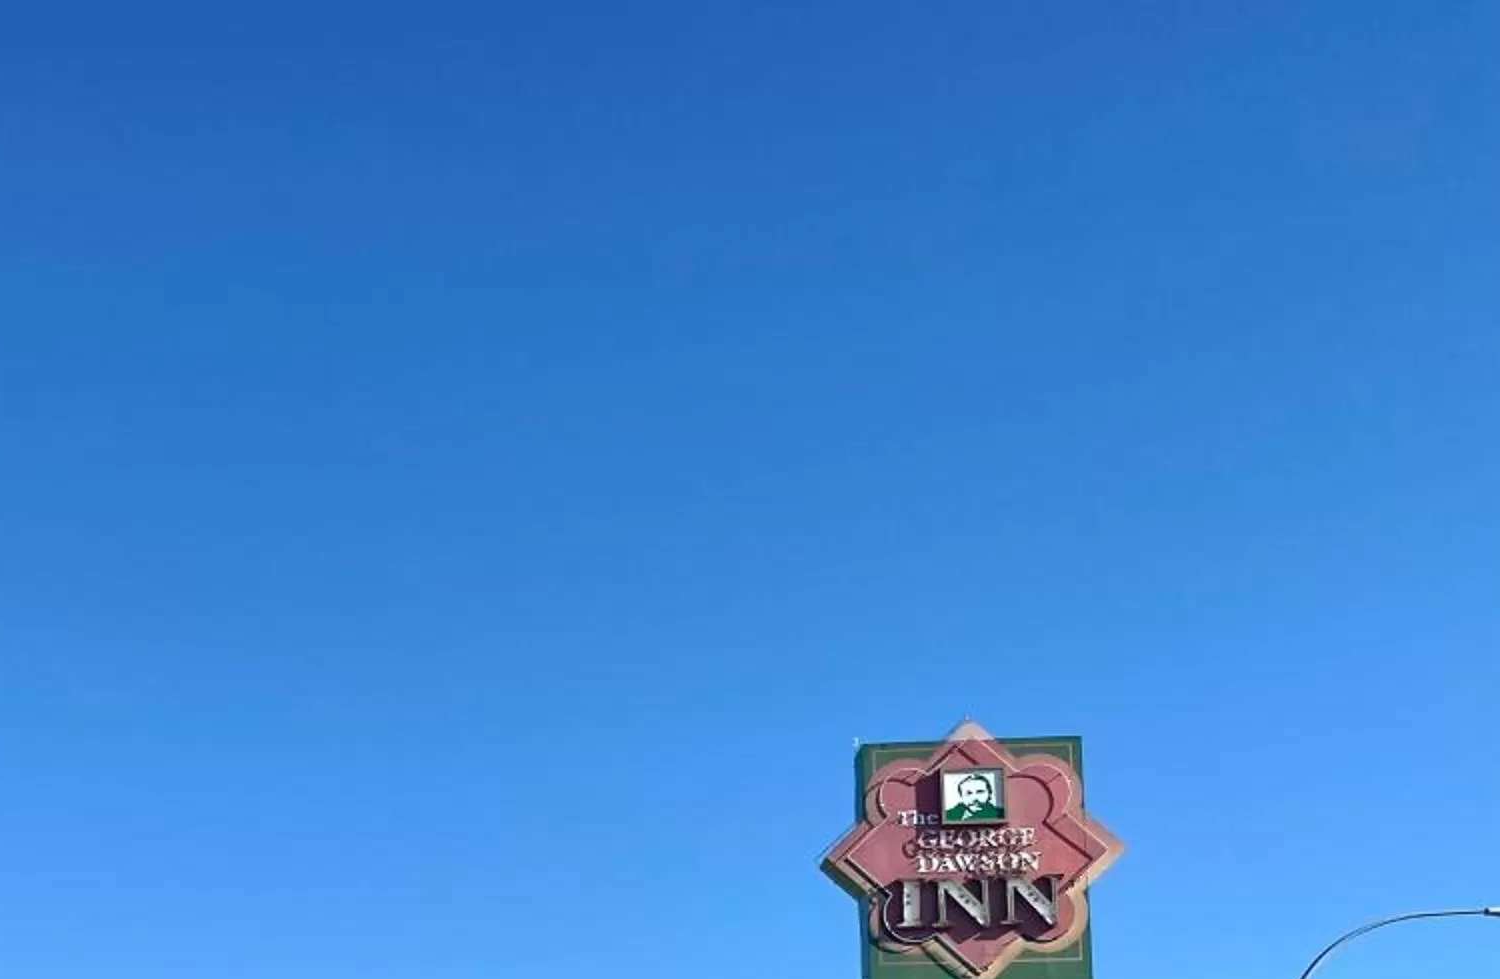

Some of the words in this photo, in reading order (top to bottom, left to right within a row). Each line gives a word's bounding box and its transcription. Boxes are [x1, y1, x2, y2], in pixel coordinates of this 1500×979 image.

[898, 809, 939, 826] The
[917, 827, 1036, 850] GEORGE
[916, 851, 1042, 873] DAWSON
[896, 875, 1064, 929] INN
